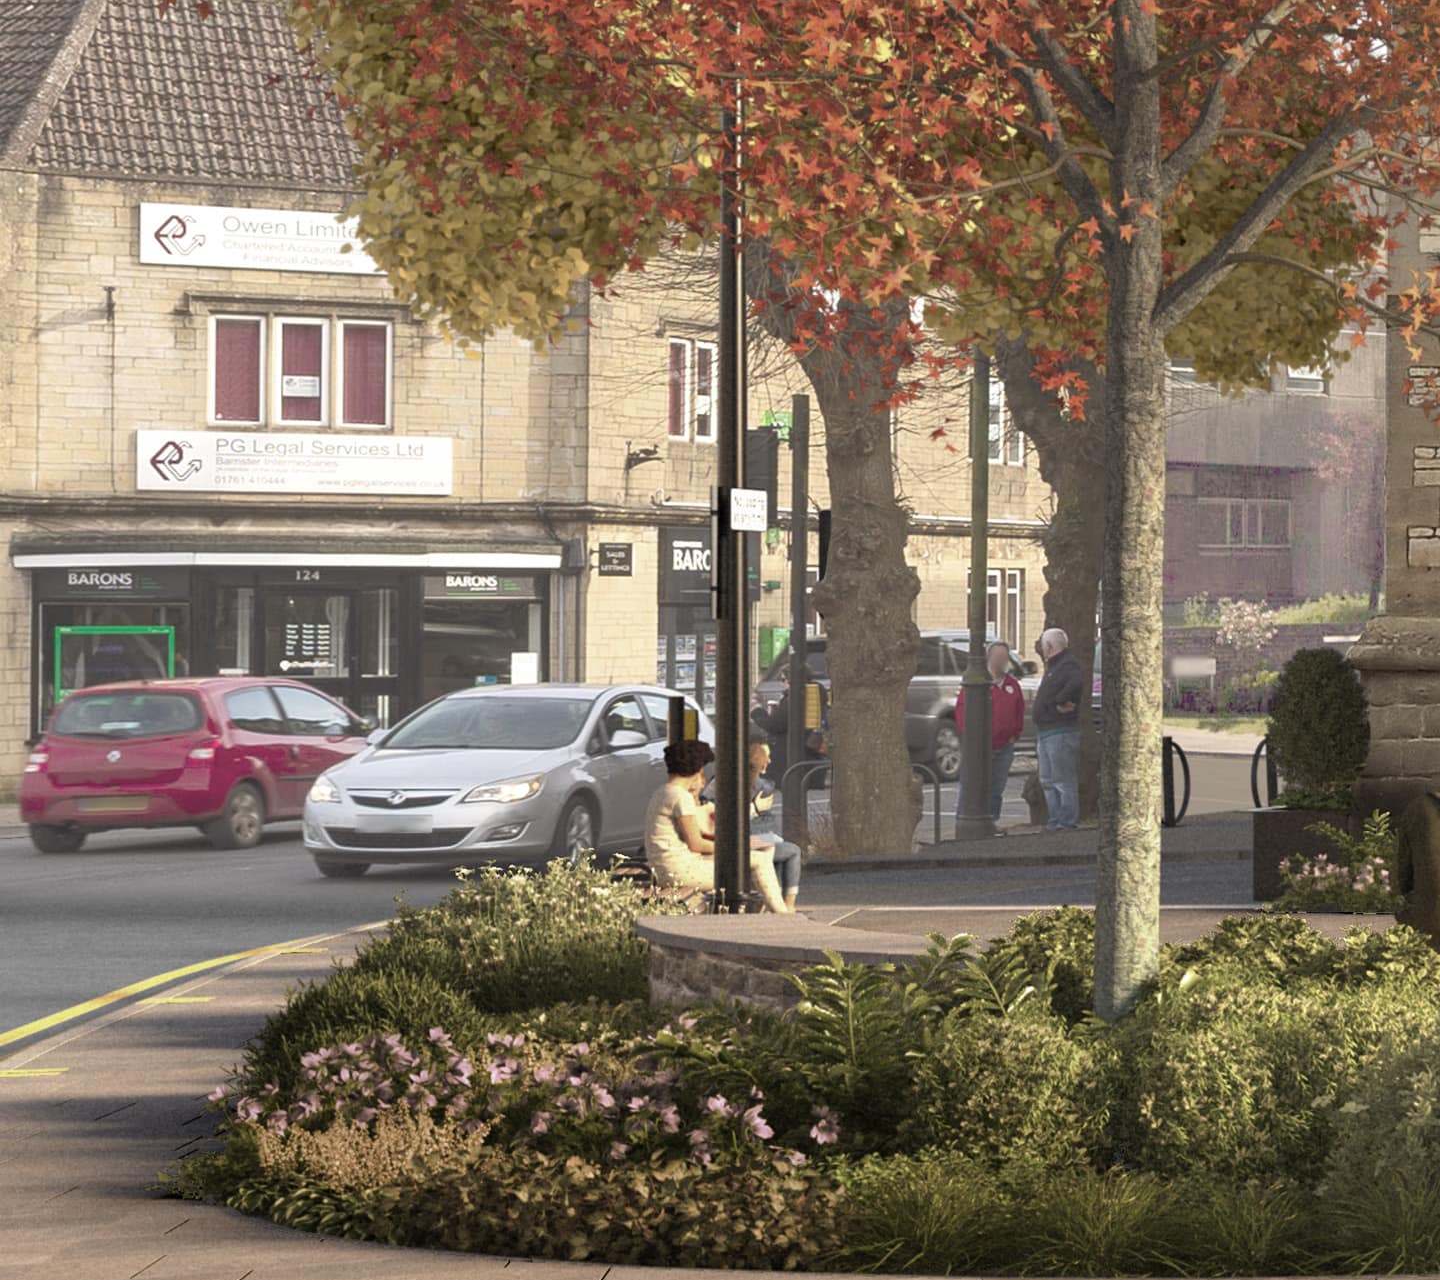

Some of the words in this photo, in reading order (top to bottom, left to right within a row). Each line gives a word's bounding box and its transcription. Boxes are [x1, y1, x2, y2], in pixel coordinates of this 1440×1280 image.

[223, 216, 287, 235] Owen
[216, 438, 246, 454] PG
[252, 439, 303, 457] Legal
[311, 440, 390, 457] Services
[396, 442, 424, 457] Ltd
[67, 573, 133, 585] BARONS
[295, 569, 320, 581] 124
[445, 575, 498, 587] BARONS
